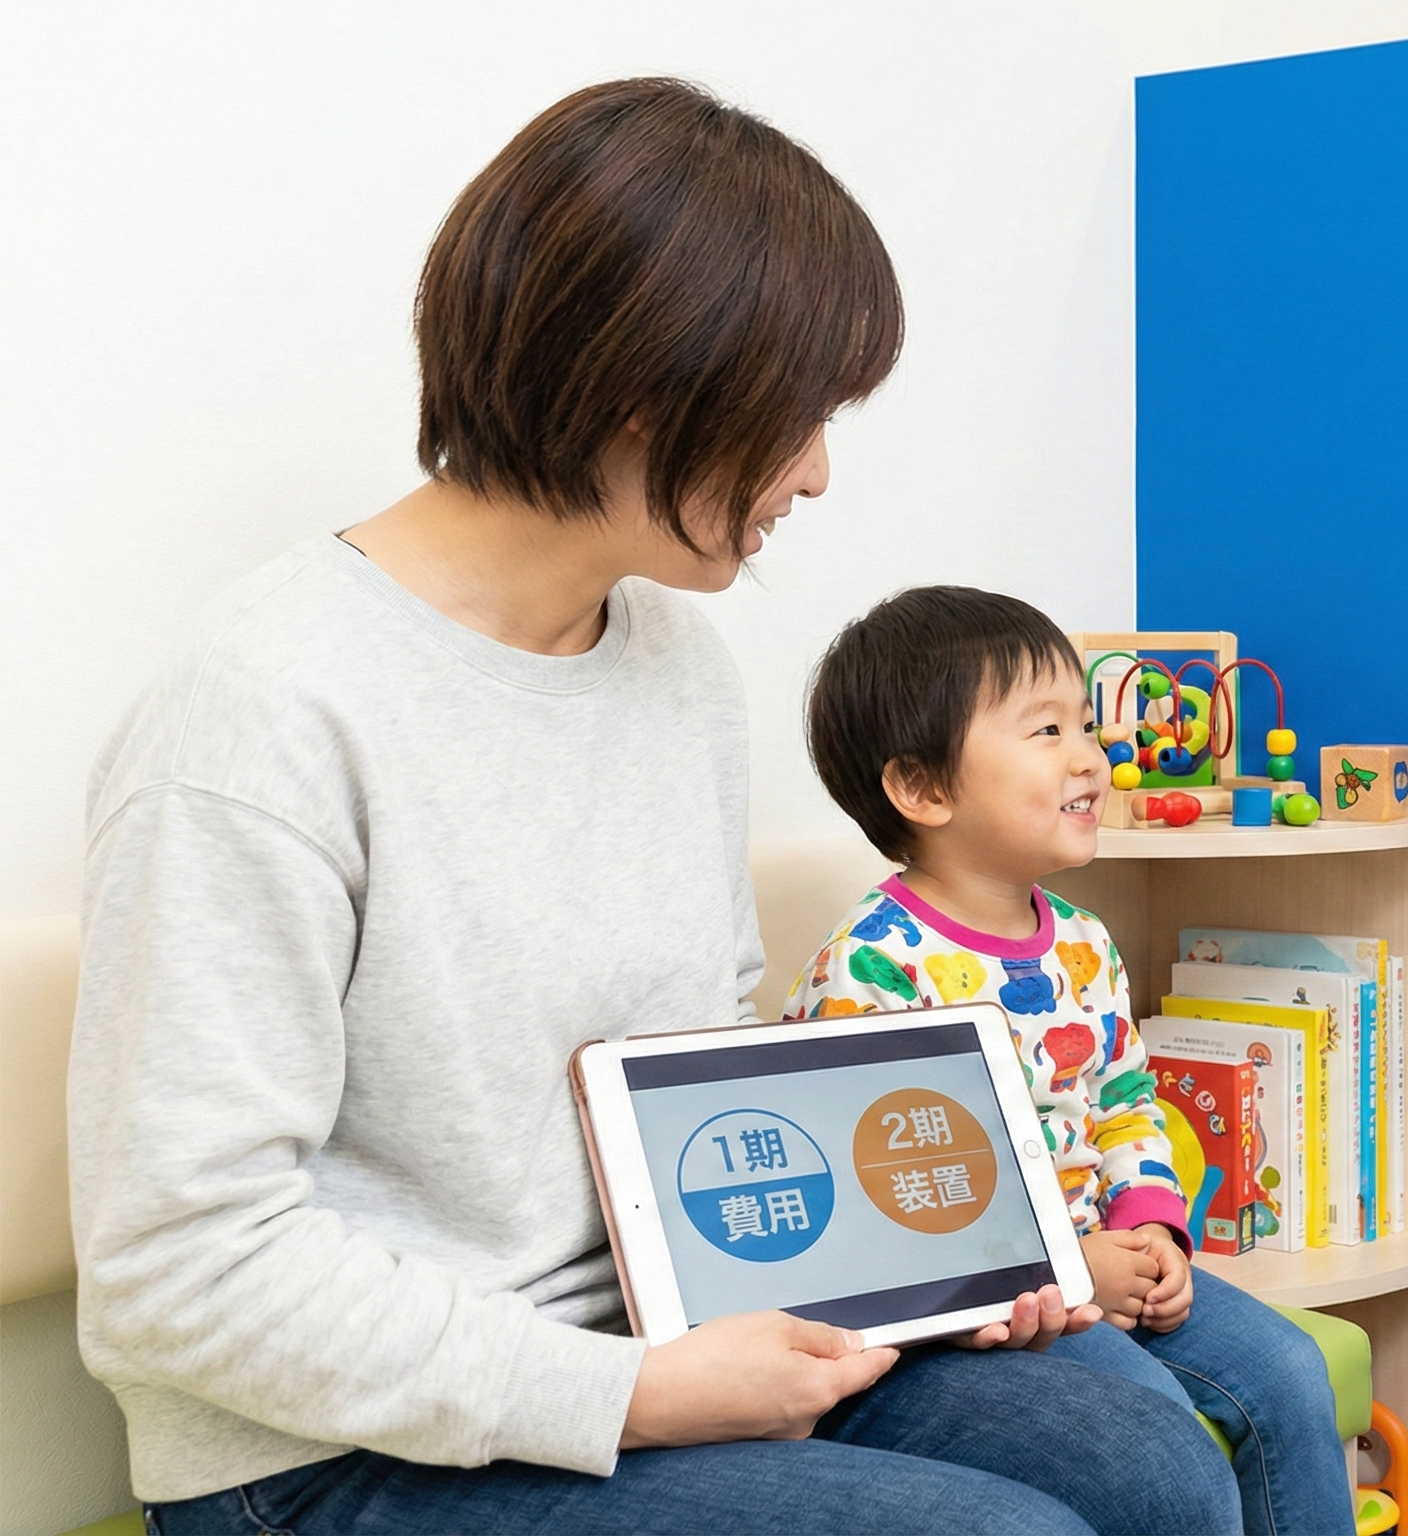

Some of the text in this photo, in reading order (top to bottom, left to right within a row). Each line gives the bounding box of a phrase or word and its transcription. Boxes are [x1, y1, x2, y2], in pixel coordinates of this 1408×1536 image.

[711, 1127, 789, 1174] 1期
[881, 1105, 954, 1151] 2期
[890, 1164, 978, 1215] 装置
[718, 1188, 811, 1243] 費用
